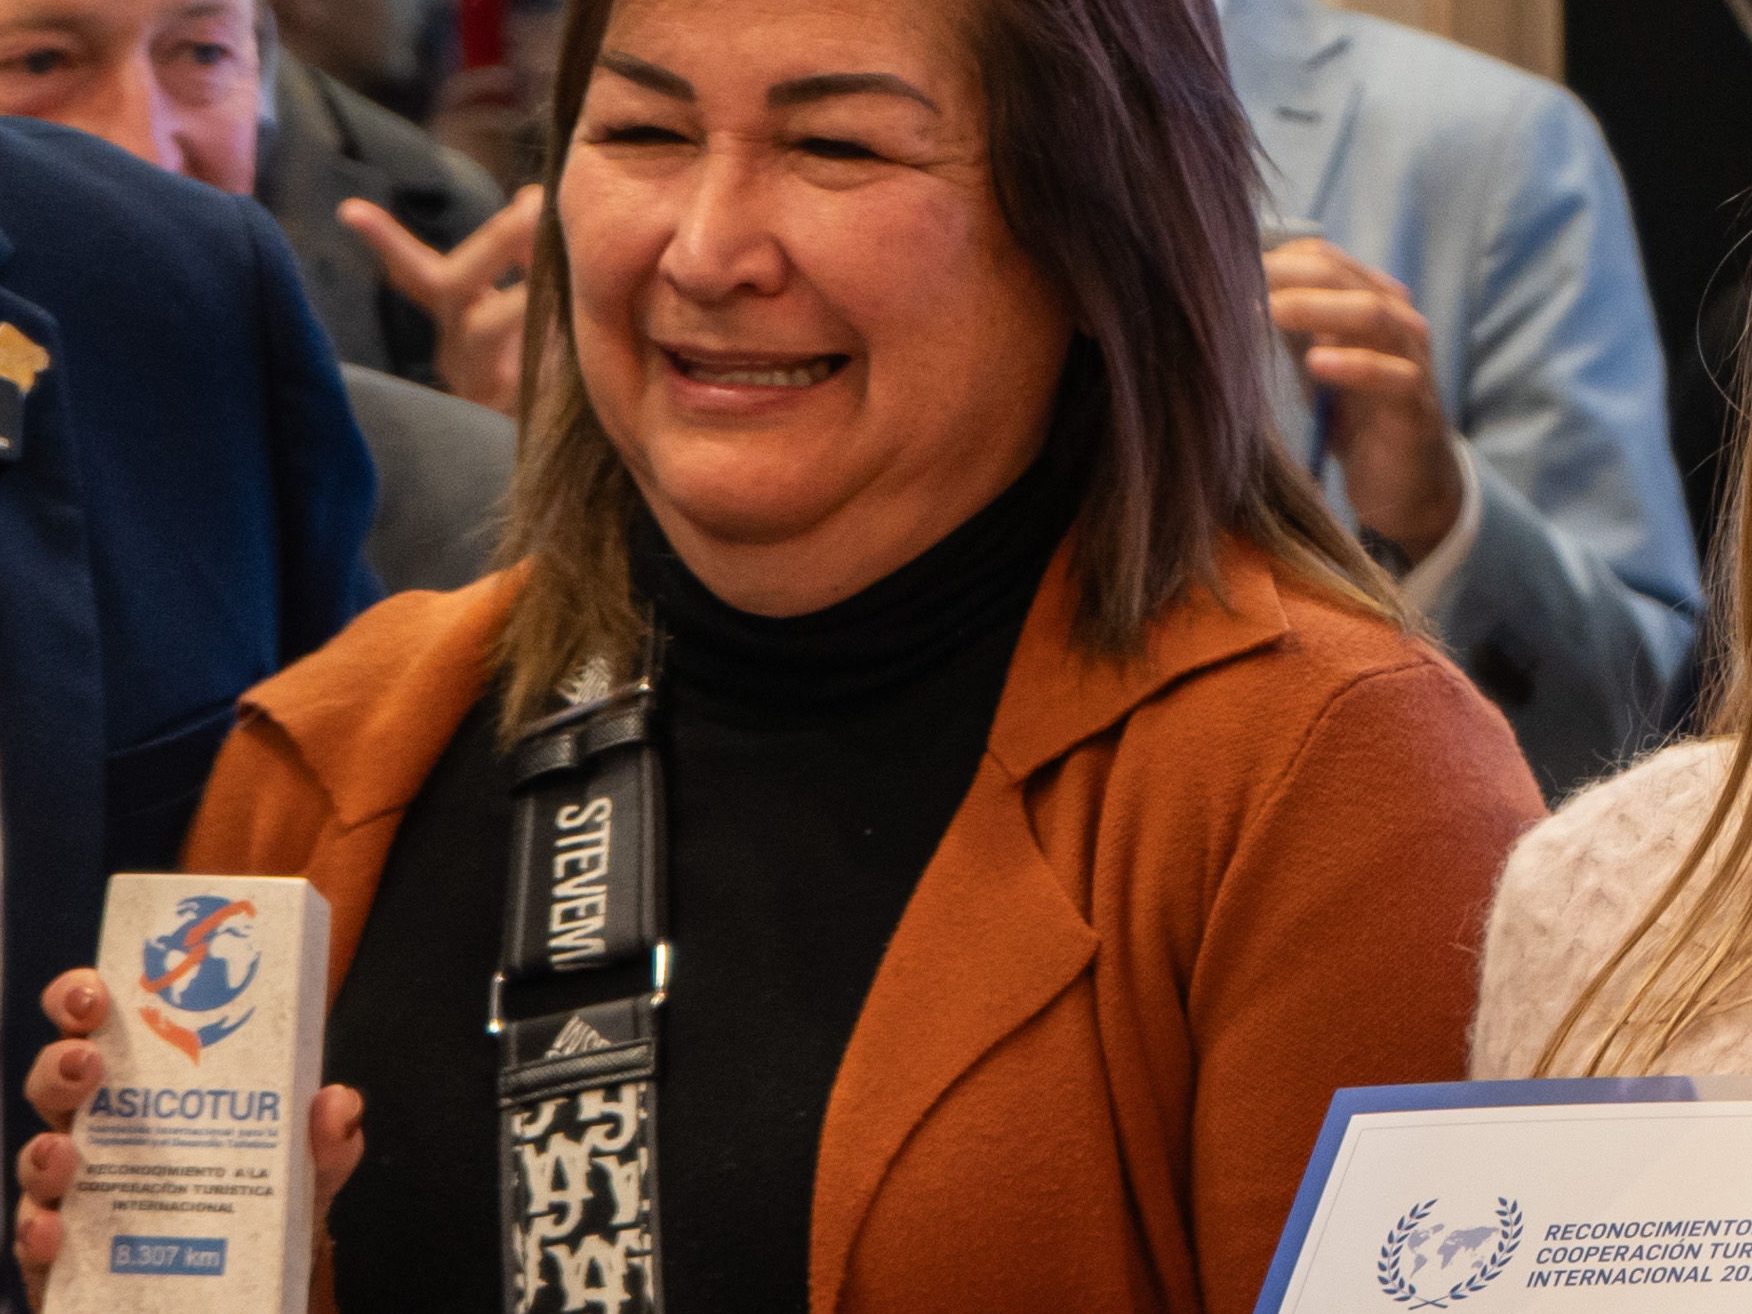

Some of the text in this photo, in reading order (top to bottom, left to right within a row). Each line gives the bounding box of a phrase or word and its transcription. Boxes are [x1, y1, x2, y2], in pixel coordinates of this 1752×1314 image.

[548, 797, 612, 973] STEVEM
[89, 1088, 280, 1121] ASICOTUR
[117, 1245, 220, 1267] 8.307 km
[1536, 1238, 1705, 1265] COOPERACIÓN
[1527, 1266, 1714, 1288] INTERNACIONAL
